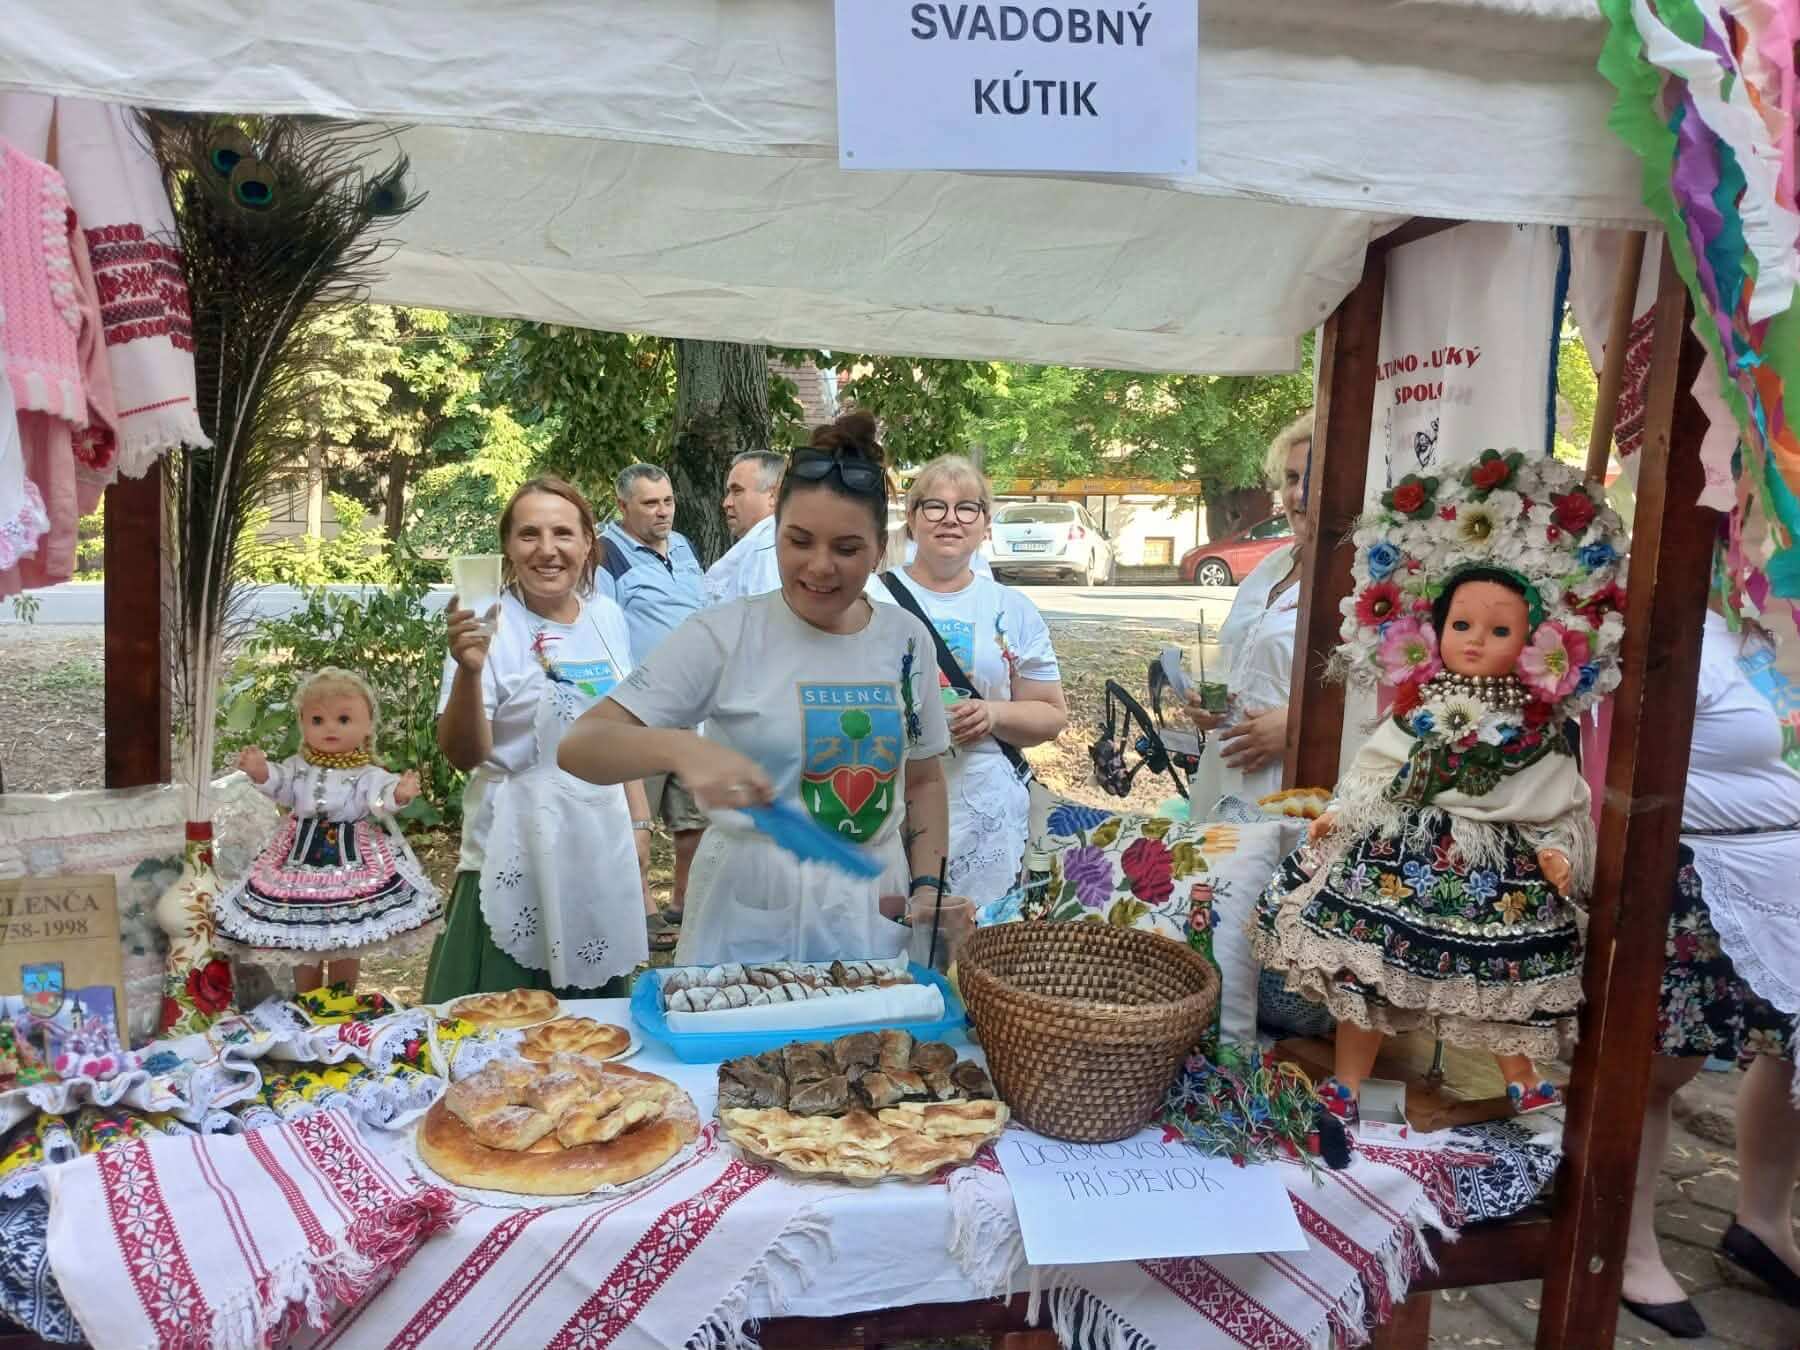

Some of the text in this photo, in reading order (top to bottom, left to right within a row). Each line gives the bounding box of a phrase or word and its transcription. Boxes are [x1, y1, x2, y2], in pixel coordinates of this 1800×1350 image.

[911, 1, 1152, 47] SVADOBNÝ
[974, 69, 1099, 117] KÚTIK
[1395, 381, 1443, 405] SPOL
[804, 687, 893, 703] SELENČA
